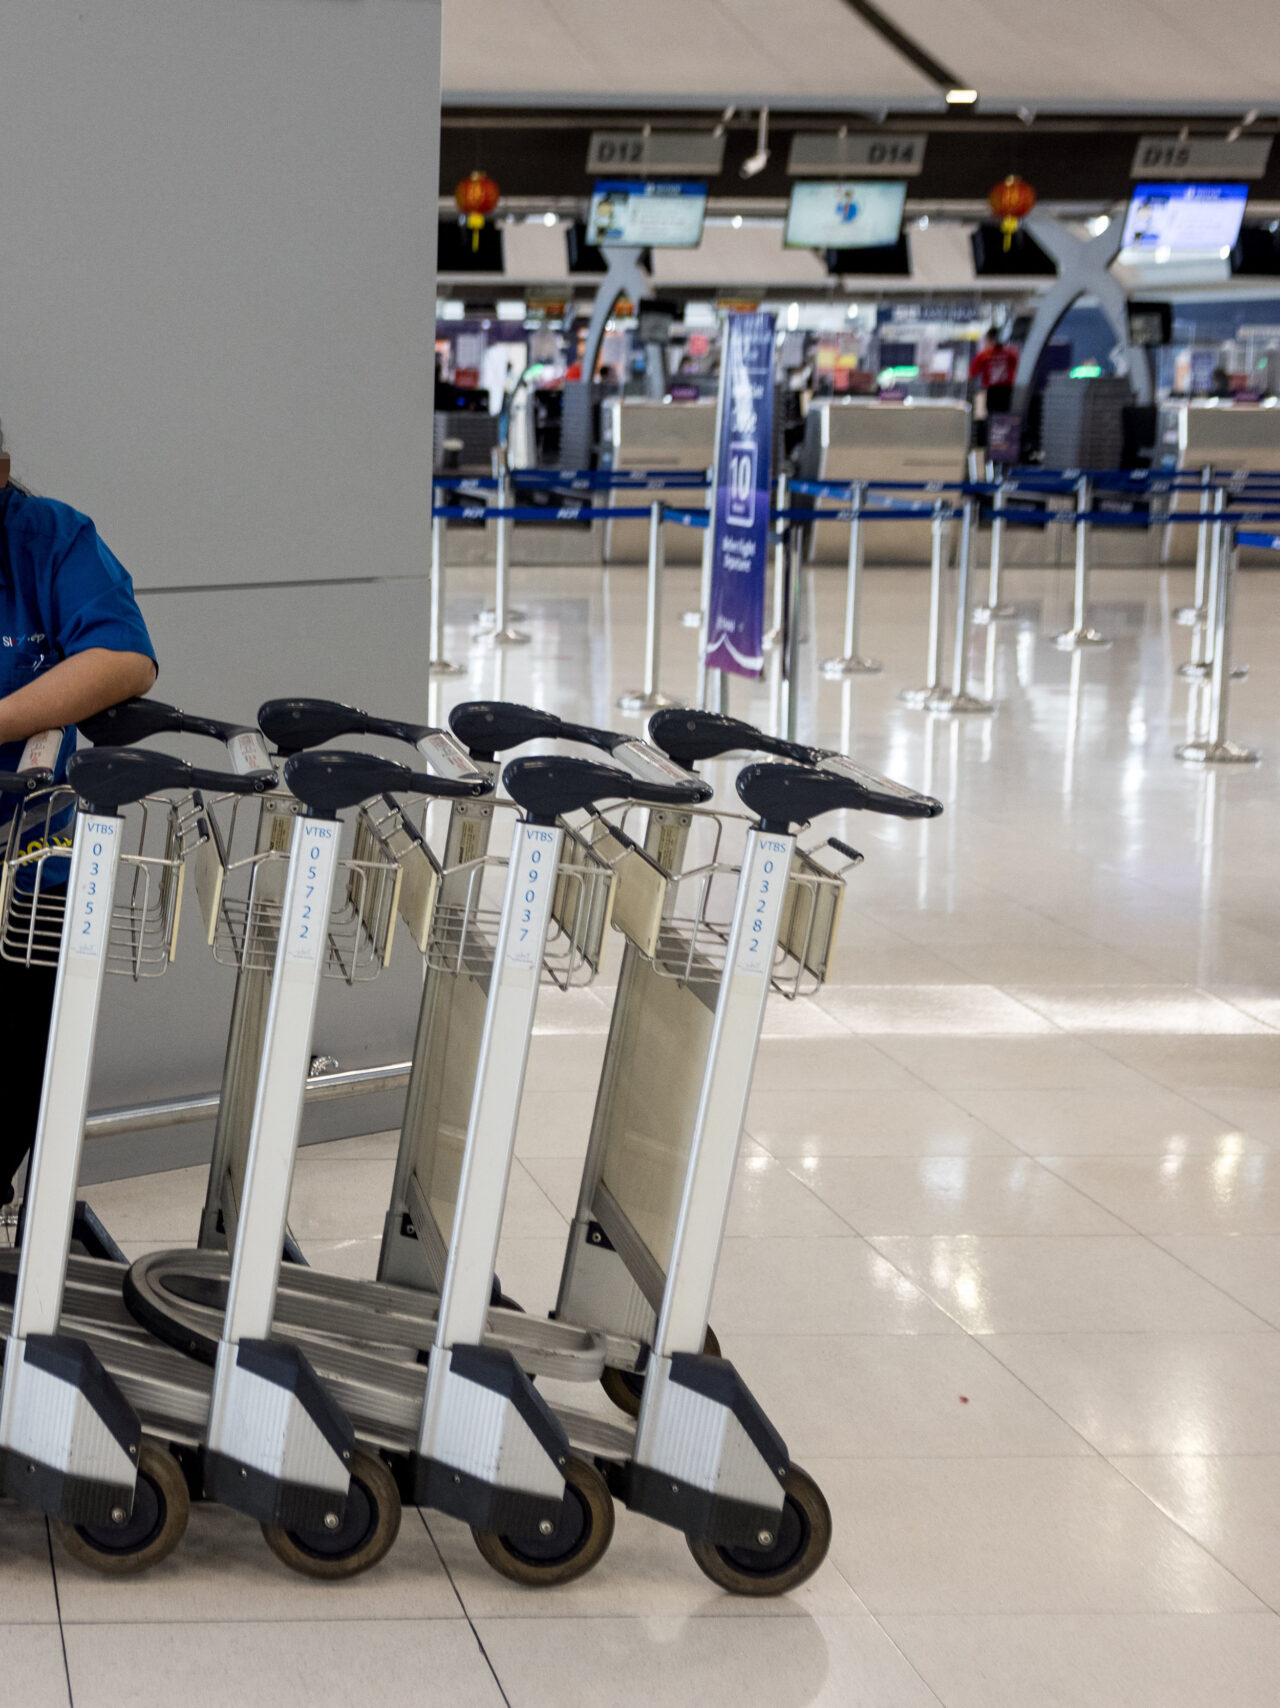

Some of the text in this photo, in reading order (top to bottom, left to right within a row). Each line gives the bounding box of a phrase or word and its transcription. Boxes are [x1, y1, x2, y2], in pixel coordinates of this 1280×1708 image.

[87, 822, 114, 836] VTBS
[305, 826, 332, 839] VTBS
[526, 828, 553, 843] VTBS
[759, 840, 787, 853] VTBS
[82, 842, 103, 935] 03352
[299, 846, 321, 940] 05722
[519, 850, 542, 942] 09037
[749, 860, 775, 953] 03282
